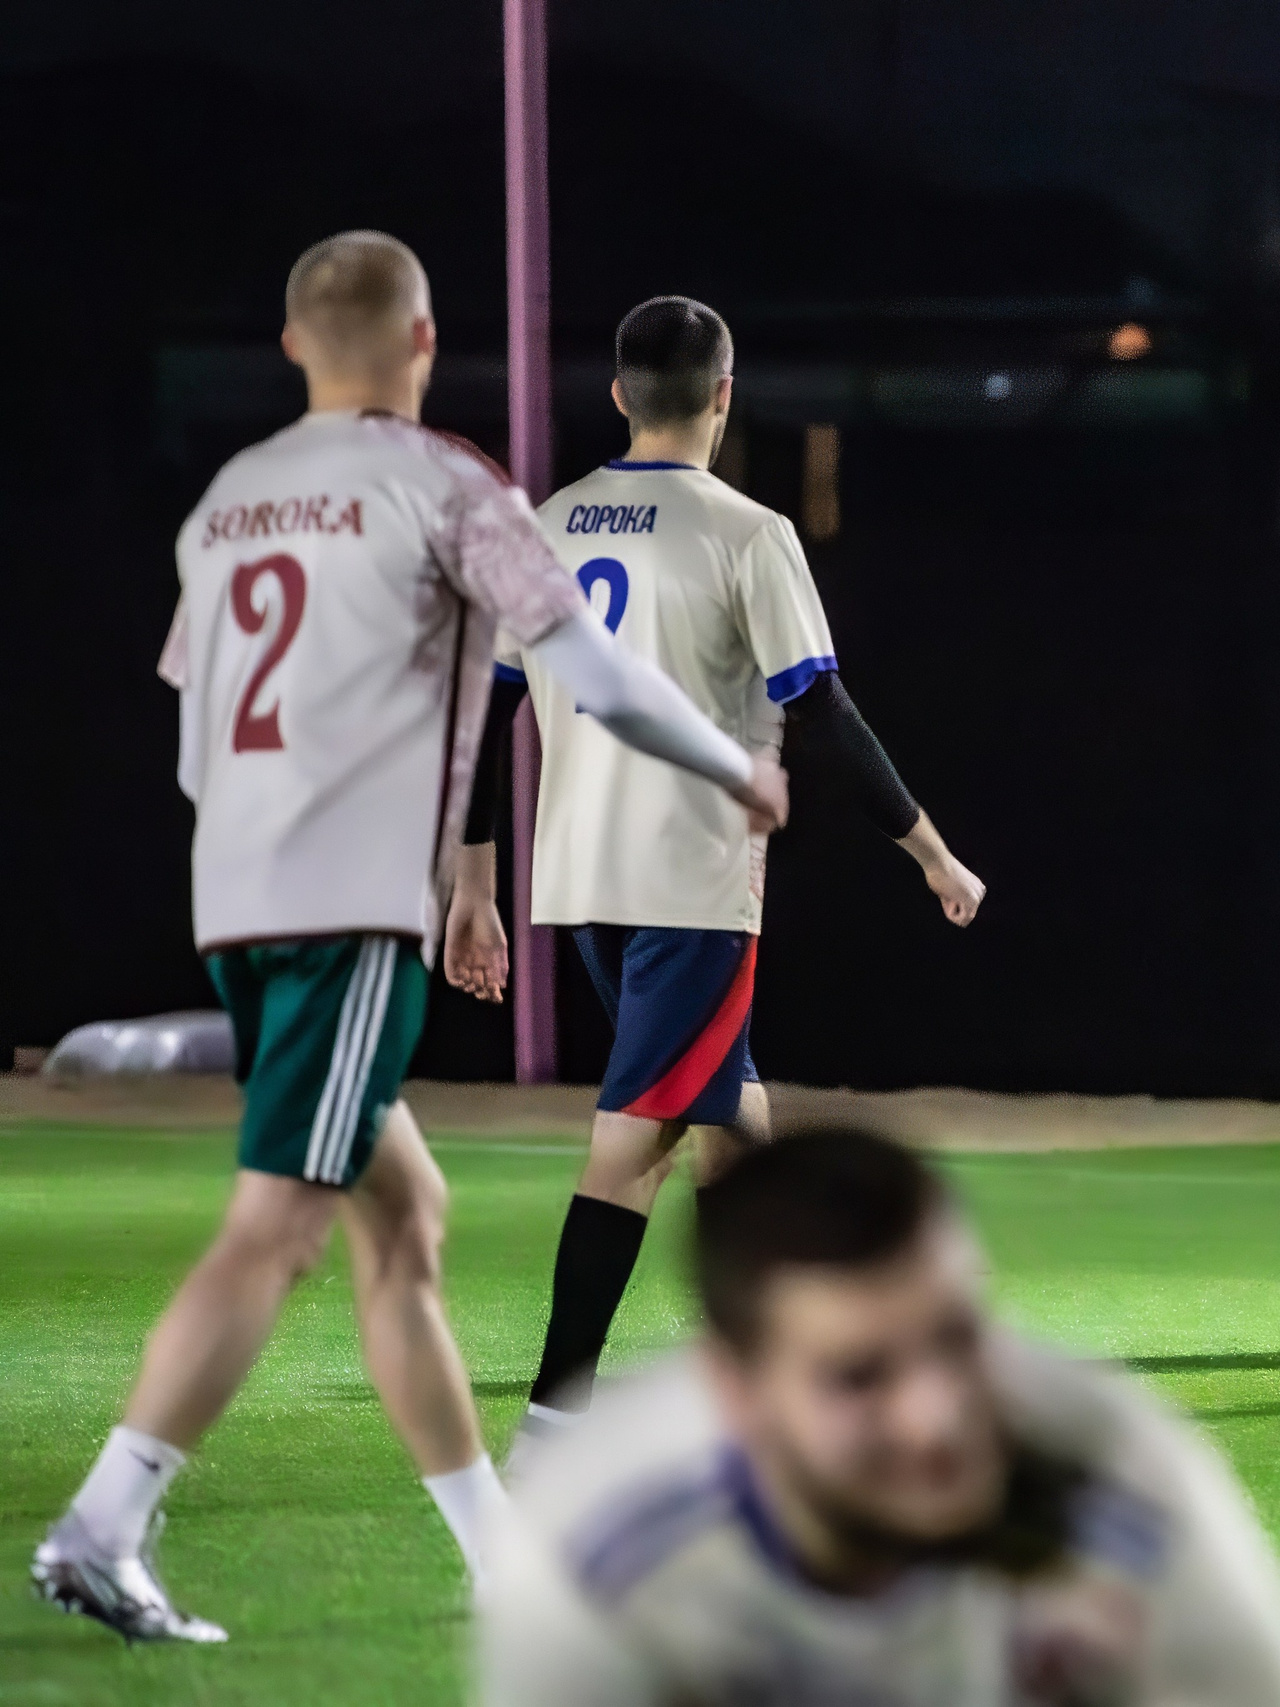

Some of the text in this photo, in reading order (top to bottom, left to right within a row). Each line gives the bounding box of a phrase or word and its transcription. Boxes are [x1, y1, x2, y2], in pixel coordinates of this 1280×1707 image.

[202, 493, 365, 548] SOROKA
[566, 504, 658, 534] СОРОКА
[230, 552, 307, 754] 2
